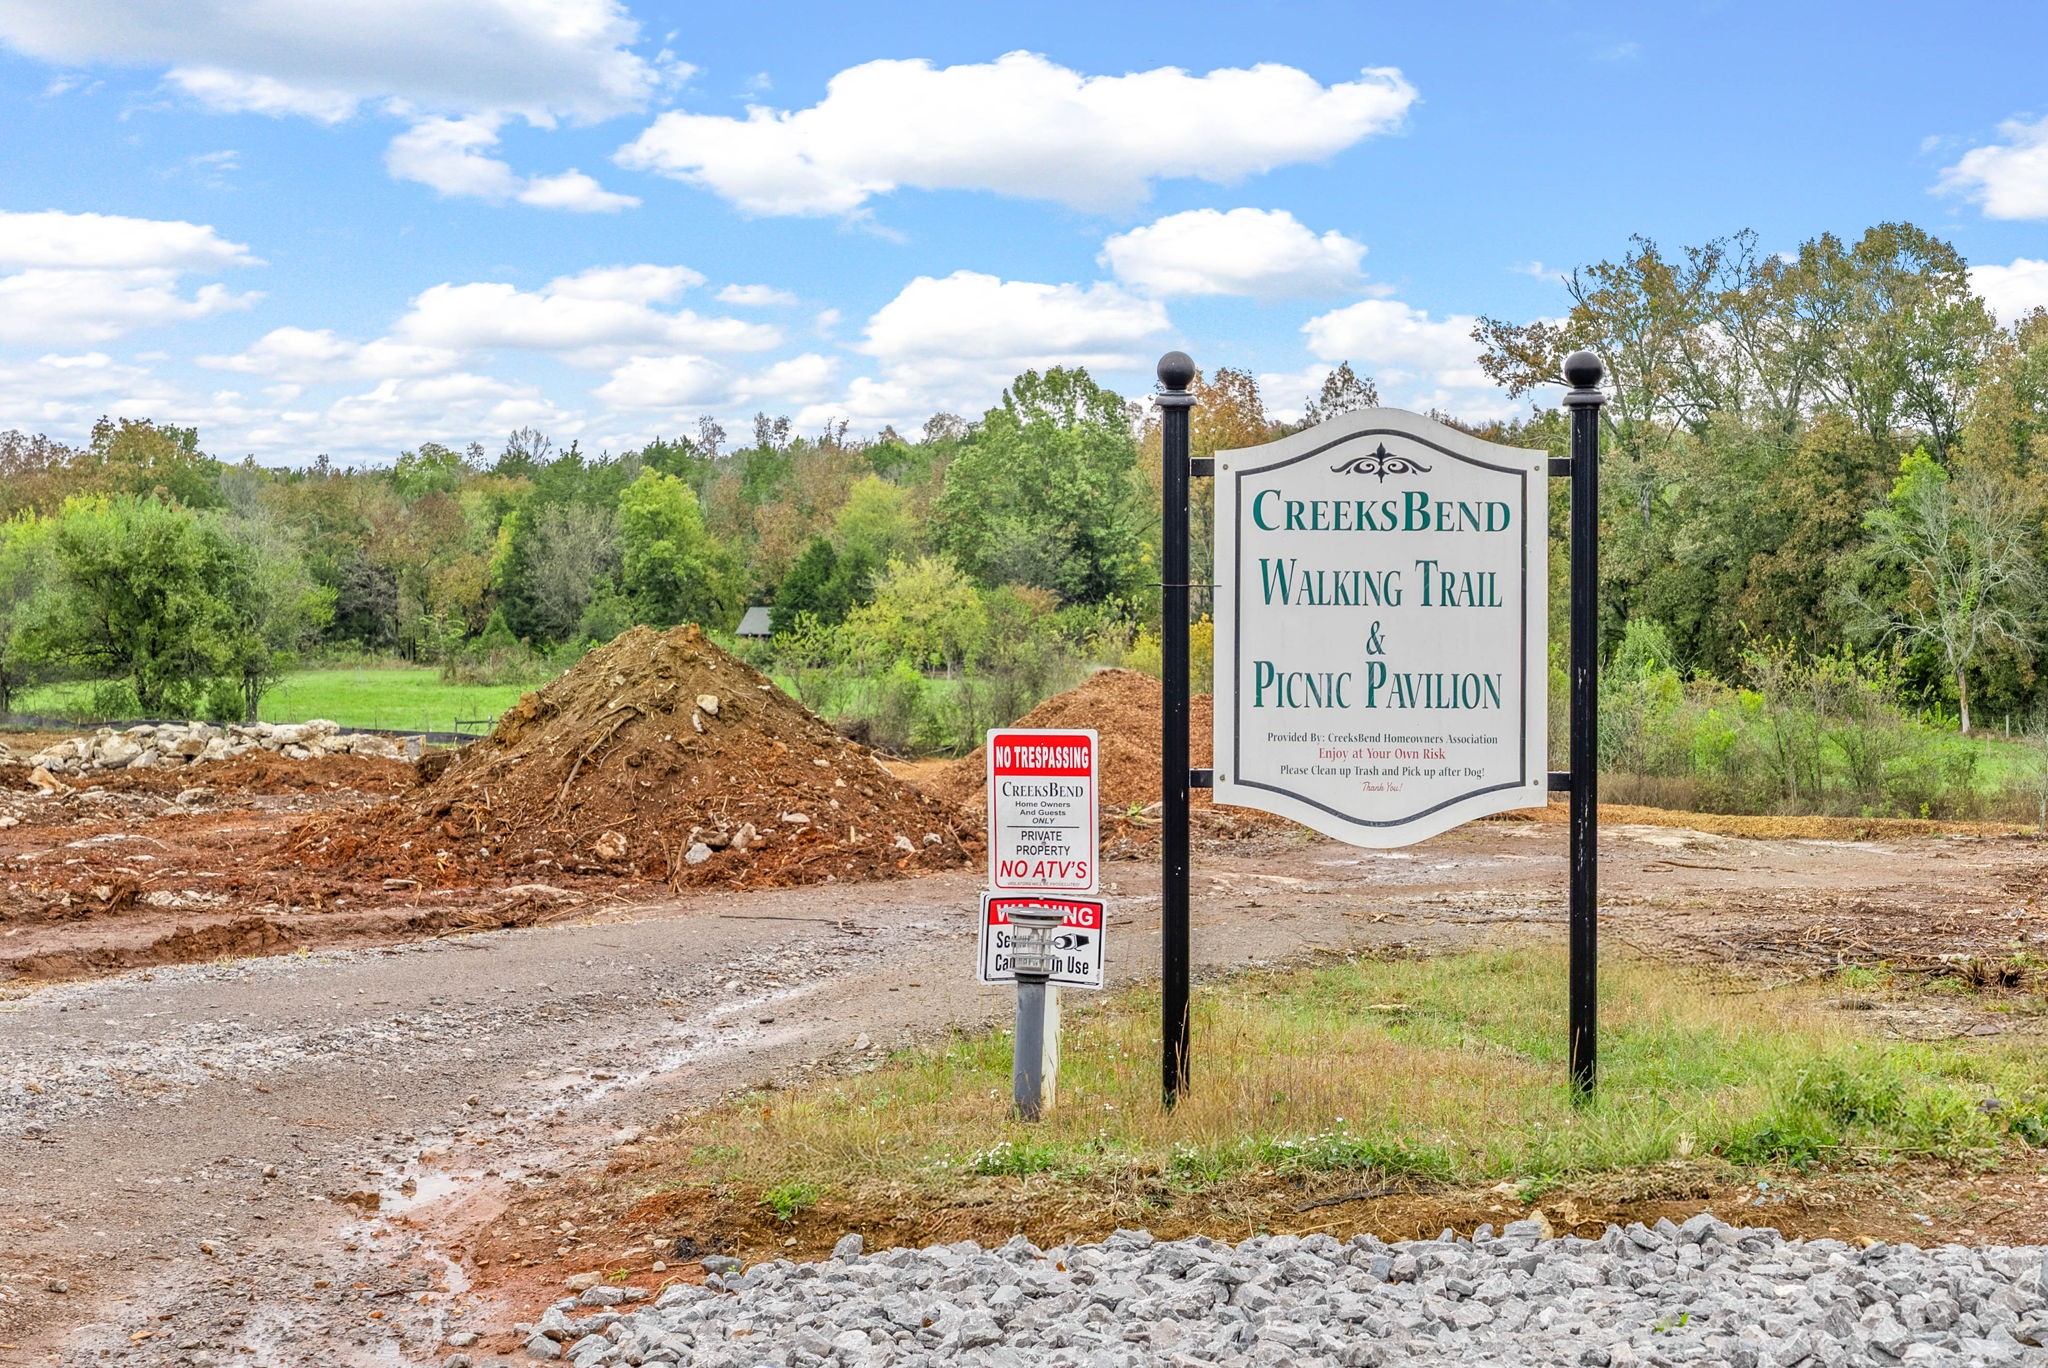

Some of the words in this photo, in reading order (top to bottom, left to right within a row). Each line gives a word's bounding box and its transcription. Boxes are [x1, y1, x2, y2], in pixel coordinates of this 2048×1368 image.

[1252, 489, 1511, 532] CREEKSBEND
[1258, 558, 1403, 607] WALKING
[1415, 559, 1503, 608] TRAIL
[1366, 620, 1386, 655] &
[1253, 660, 1352, 709] PICNIC
[1365, 661, 1502, 709] PAVILION
[1267, 732, 1308, 742] Provided
[1328, 733, 1381, 743] CreeksBend
[1384, 733, 1444, 744] Homeowners
[1446, 734, 1498, 745] Association
[996, 746, 1011, 768] NO
[1014, 746, 1089, 769] TRESPASSING
[1319, 747, 1349, 762] Enjoy
[1352, 748, 1363, 759] at
[1367, 748, 1391, 759] Your
[1394, 748, 1419, 760] Own
[1423, 747, 1446, 760] Risk
[1280, 765, 1309, 775] Please
[1311, 765, 1337, 775] Clean
[1339, 768, 1351, 778] up
[1354, 765, 1379, 776] Trash
[1381, 766, 1399, 776] and
[1402, 766, 1421, 777] Pick
[1424, 769, 1436, 779] up
[1439, 766, 1462, 777] after
[1464, 767, 1485, 779] Dog!
[1002, 781, 1084, 798] CREEKSBEND
[1362, 781, 1385, 792] Thank
[1032, 817, 1055, 825] ONLY
[1021, 830, 1062, 841] PRIVATE
[1016, 845, 1071, 856] PROPERTY
[1000, 860, 1028, 878] NO
[1032, 861, 1088, 879] ATV'S
[1067, 955, 1089, 975] Use
